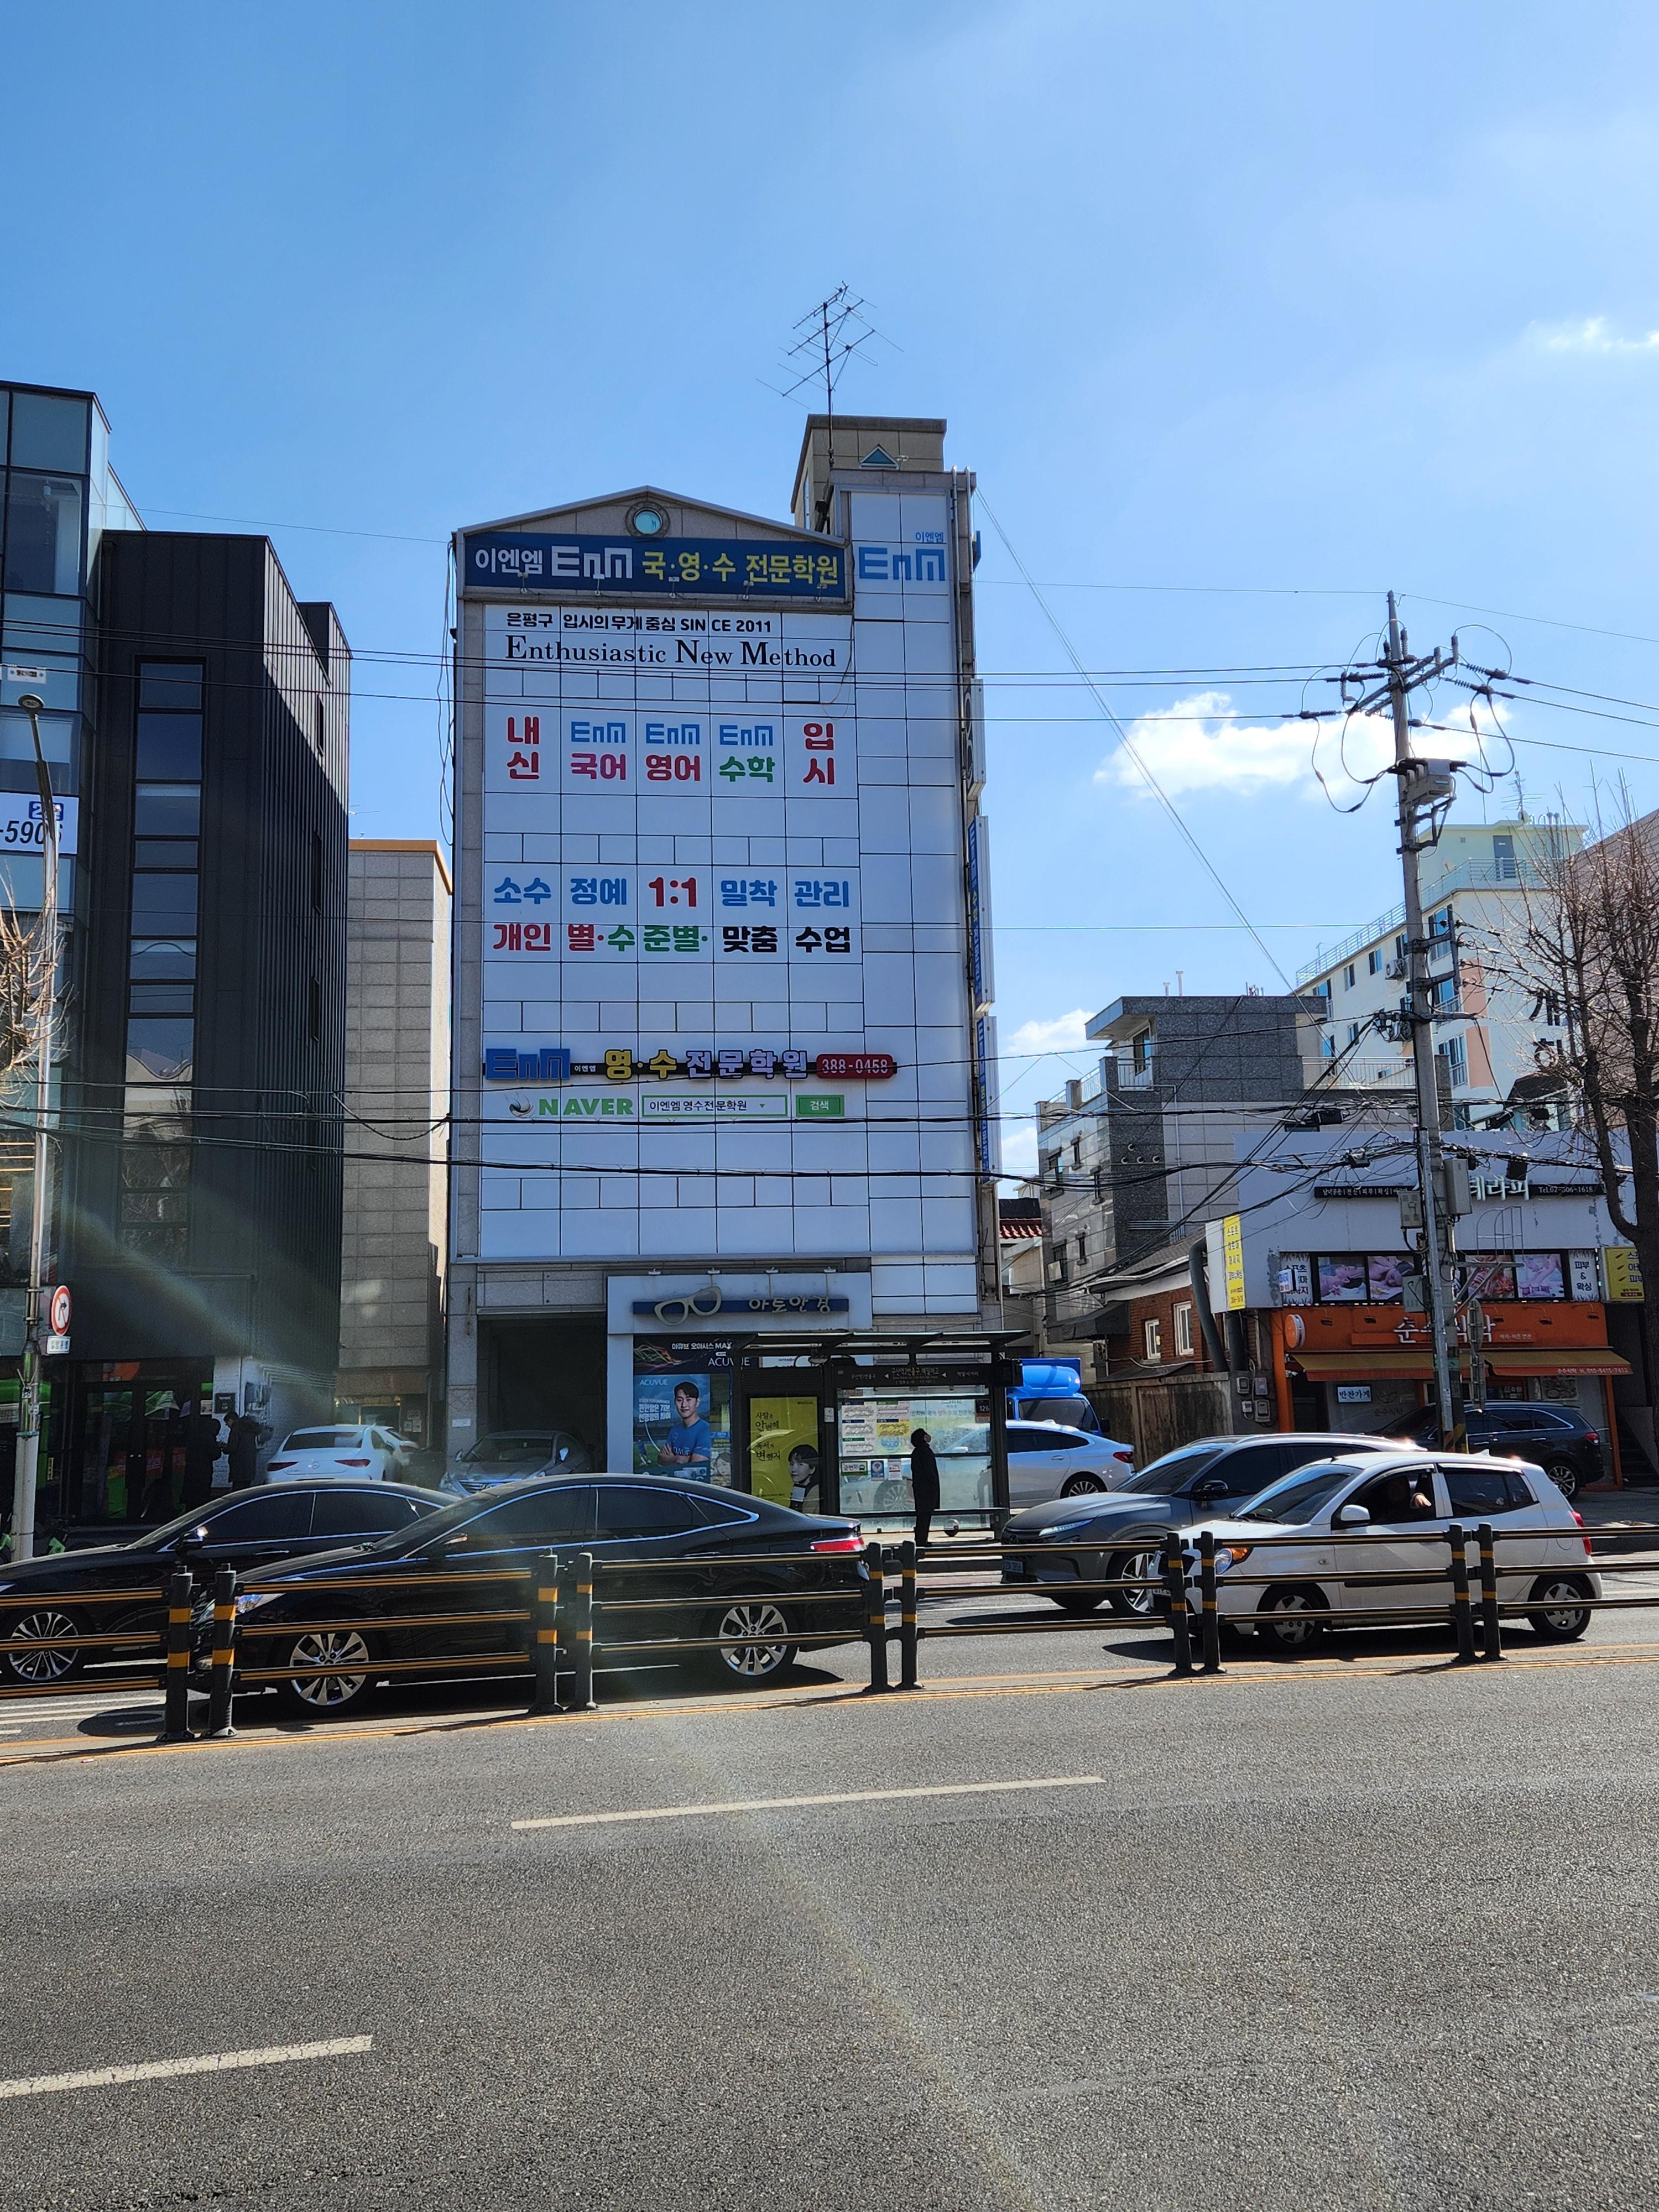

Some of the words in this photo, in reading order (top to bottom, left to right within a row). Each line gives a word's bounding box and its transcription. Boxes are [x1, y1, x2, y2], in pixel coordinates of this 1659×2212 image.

[915, 531, 943, 543] 이엔엠
[475, 548, 543, 575] 이엔엠
[745, 554, 838, 585] 전문학원
[507, 612, 553, 628] 은평구
[736, 620, 770, 632] 2011
[505, 635, 666, 663] Enthusiastic
[675, 639, 734, 665] New
[739, 641, 836, 667] Method
[570, 753, 626, 780] 국어
[645, 754, 701, 781] 영어
[719, 756, 775, 782] 수학
[493, 877, 551, 905] 소수
[570, 878, 627, 905] 정예
[649, 877, 697, 907] 1:1
[721, 879, 778, 907] 밀착
[795, 880, 849, 908] 관리
[723, 926, 778, 953] 맞춤
[795, 926, 851, 953] 수업
[686, 1049, 808, 1080] 전문학원
[822, 1058, 888, 1074] 388-0458
[539, 1098, 634, 1116] NAVER
[649, 1101, 681, 1112] 이엔엠
[684, 1100, 747, 1112] 영수전문학원
[810, 1100, 829, 1111] 검색
[1574, 1261, 1590, 1270] 피부
[1580, 1272, 1587, 1280] &
[1577, 1282, 1593, 1291] 왁싱
[1339, 1389, 1370, 1399] 반찬가게
